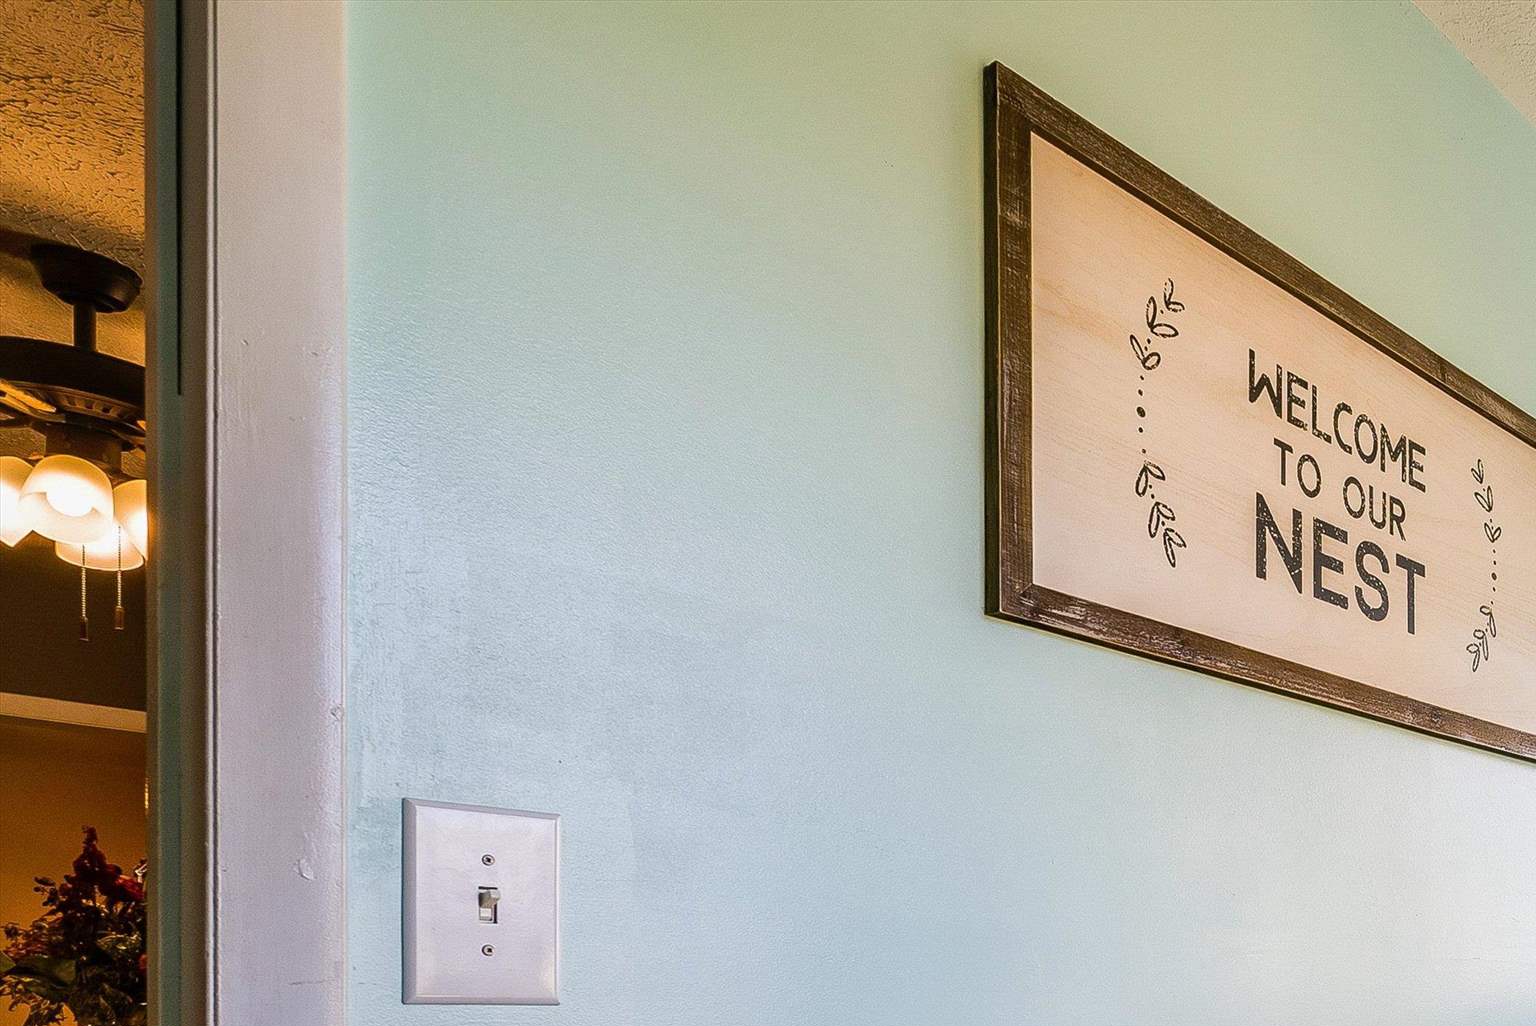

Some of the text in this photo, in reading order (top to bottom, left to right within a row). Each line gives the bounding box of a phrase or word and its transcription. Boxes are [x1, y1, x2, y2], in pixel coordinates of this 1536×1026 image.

[1248, 347, 1426, 493] WELCOME
[1273, 437, 1406, 541] TO OUR
[1255, 491, 1426, 635] NEST
